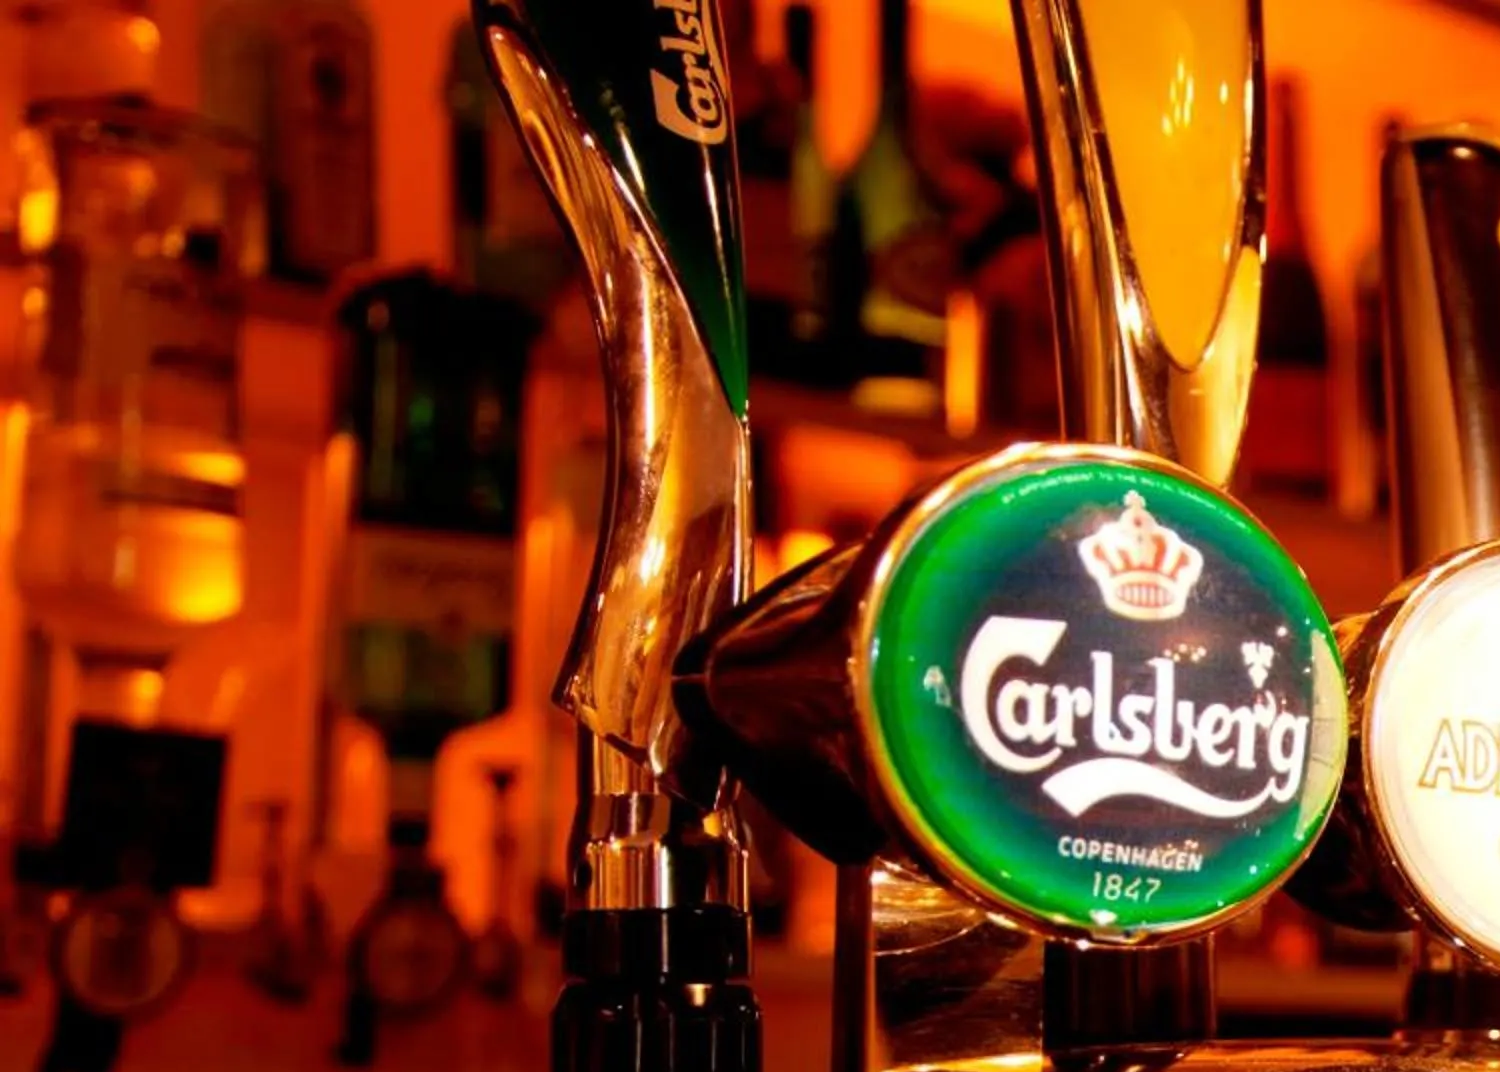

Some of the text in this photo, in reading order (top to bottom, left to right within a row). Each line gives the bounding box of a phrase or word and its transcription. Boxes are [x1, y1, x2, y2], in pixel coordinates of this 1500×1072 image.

[961, 615, 1309, 804] Carlsberg
[1058, 836, 1205, 873] COPENHAGEN
[1092, 872, 1162, 903] 1847
